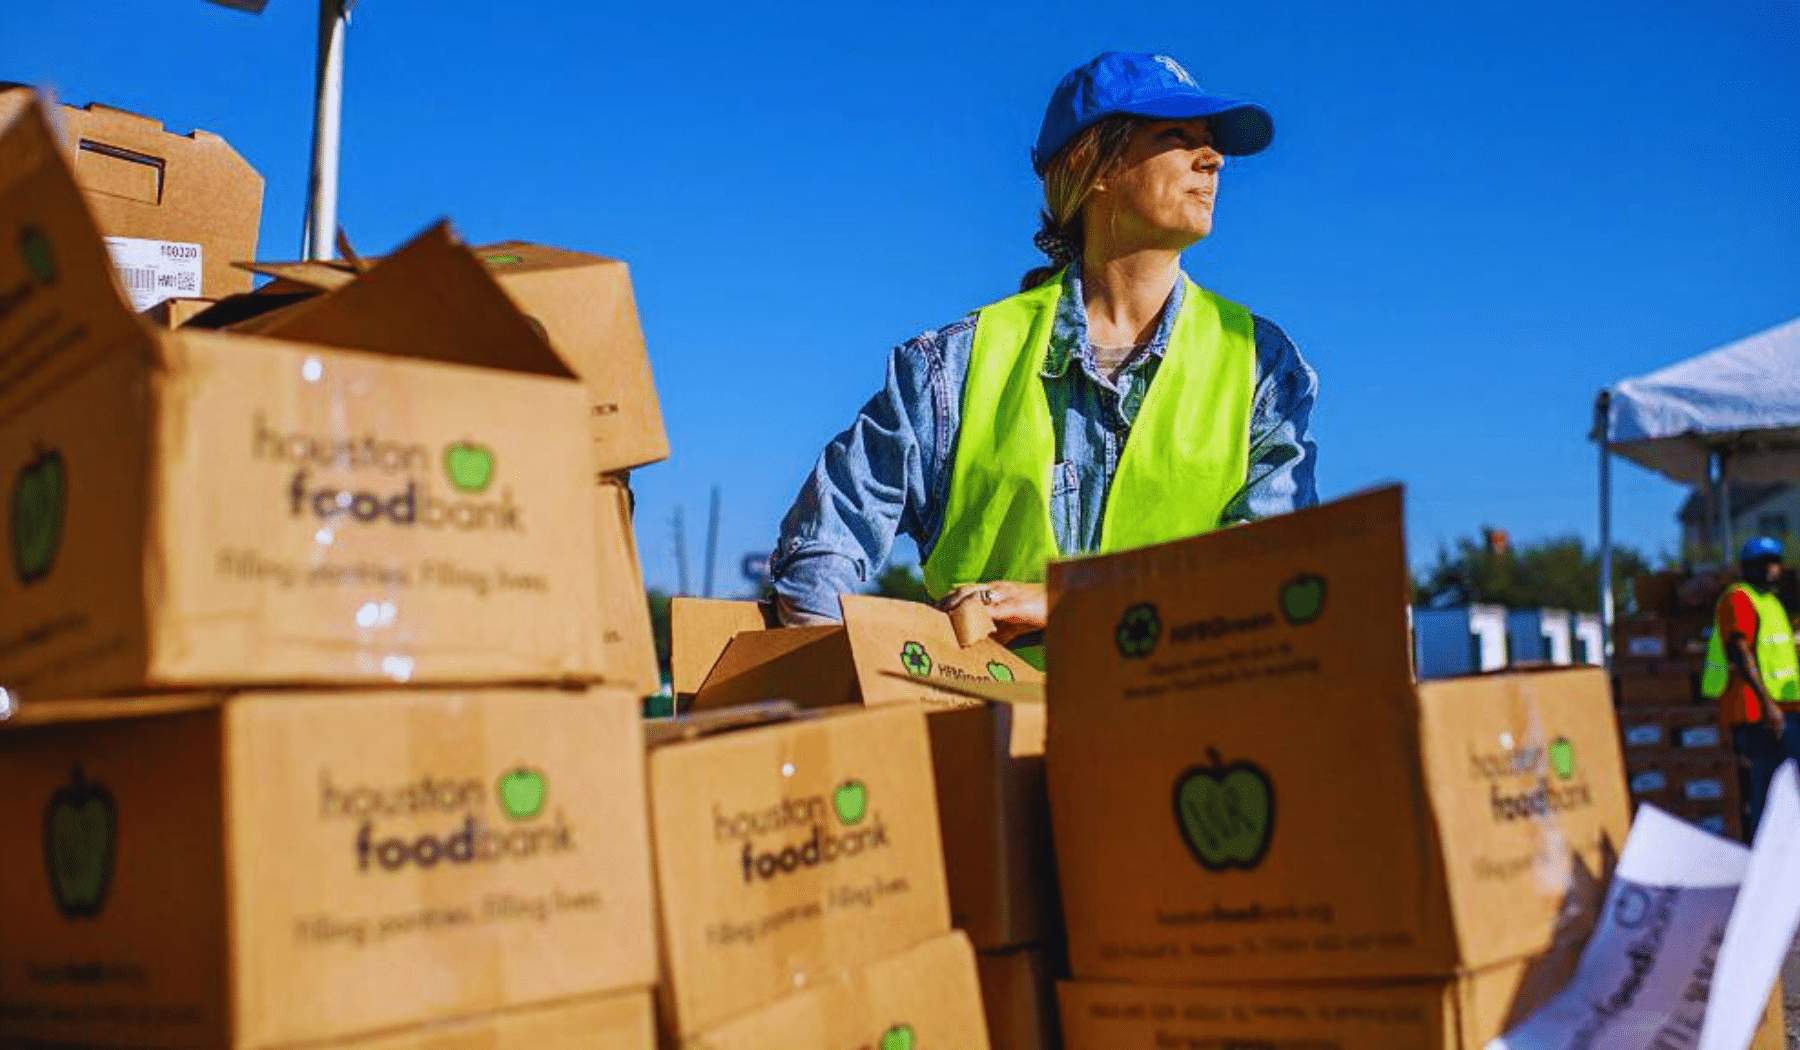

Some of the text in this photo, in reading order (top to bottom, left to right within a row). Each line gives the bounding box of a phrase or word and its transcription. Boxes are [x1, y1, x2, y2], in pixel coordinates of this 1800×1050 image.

[252, 408, 430, 474] houston
[289, 467, 526, 535] foodbank
[318, 766, 485, 820] houston
[711, 795, 827, 843] houston
[354, 806, 578, 873] foodbank
[741, 810, 890, 885] foodbank
